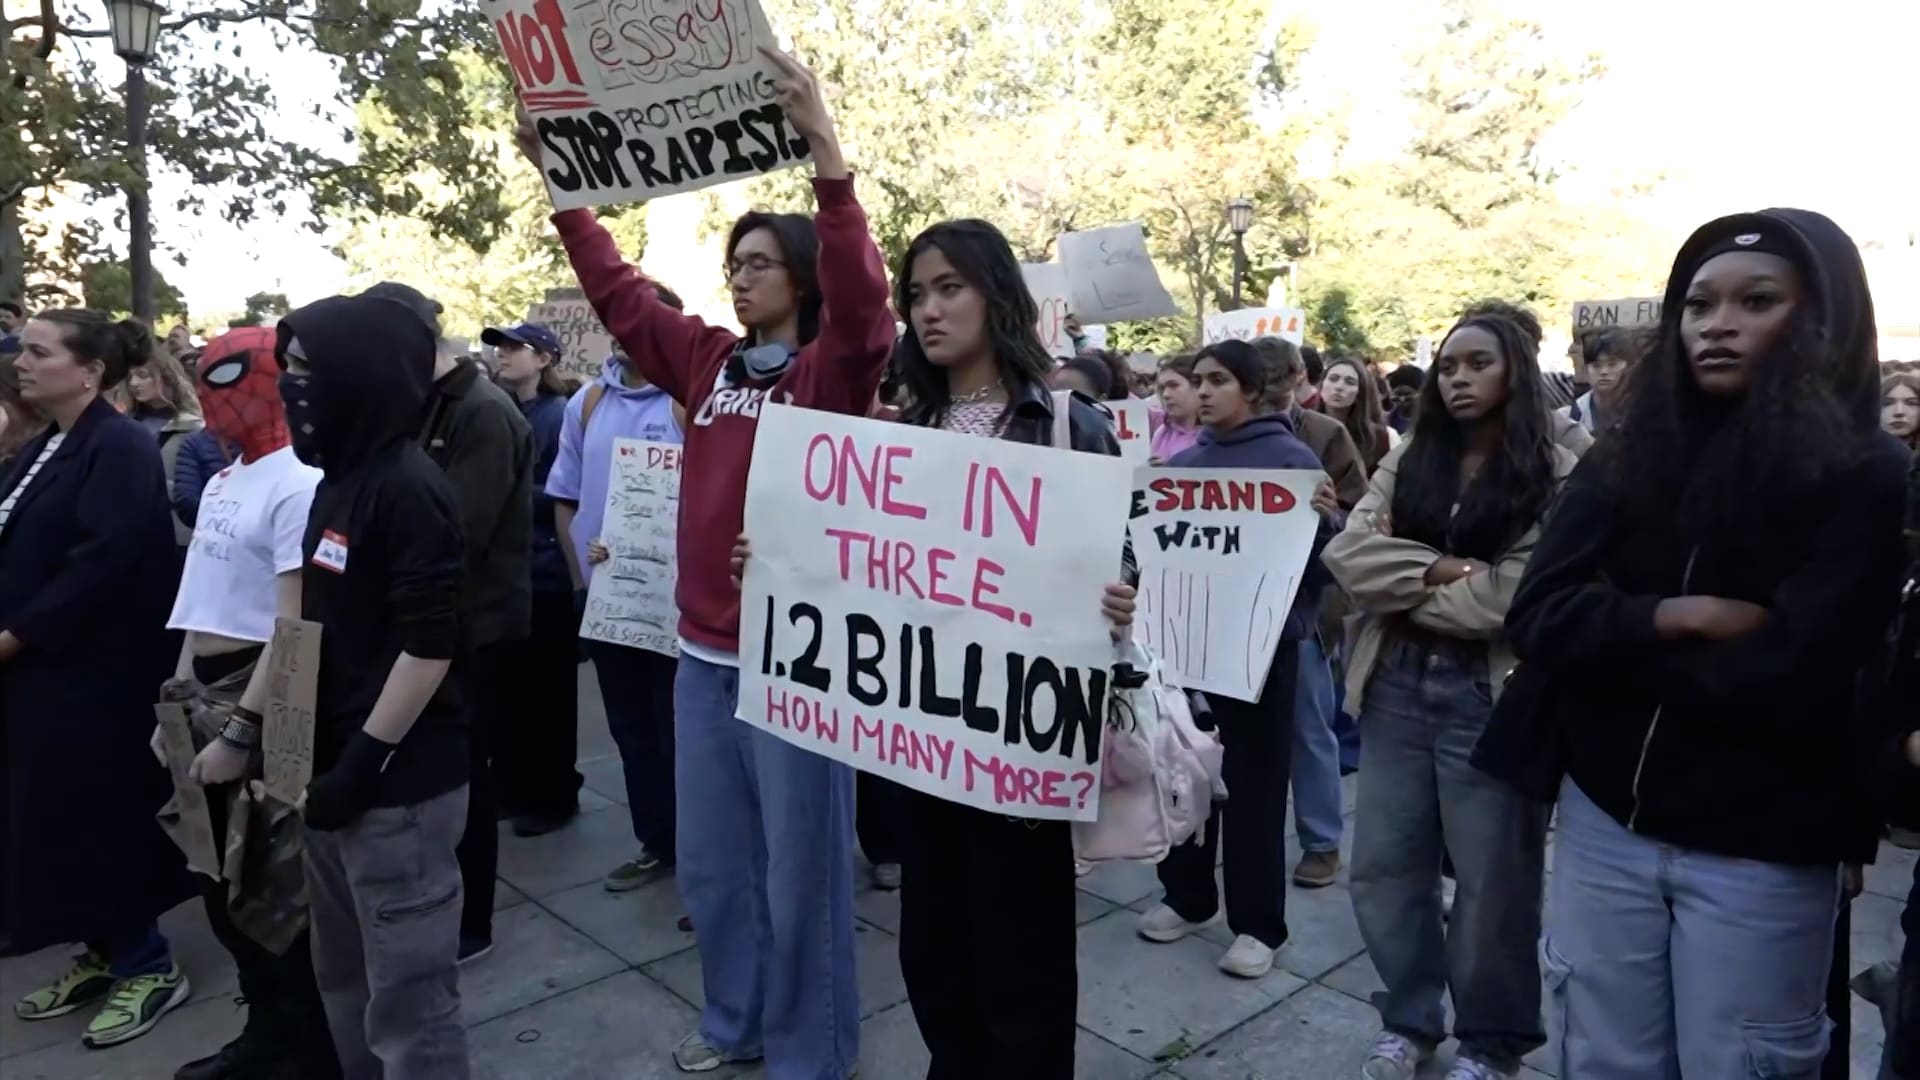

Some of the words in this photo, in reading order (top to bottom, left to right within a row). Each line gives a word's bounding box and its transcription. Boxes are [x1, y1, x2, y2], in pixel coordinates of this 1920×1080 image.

[496, 0, 584, 88] NOT
[589, 0, 732, 70] essay
[615, 71, 779, 133] PROTECTING
[537, 111, 631, 191] STOP
[1578, 304, 1619, 328] BAN
[804, 433, 927, 519] ONE
[963, 463, 1042, 546] IN
[1129, 489, 1149, 520] E
[1149, 478, 1297, 514] STAND
[825, 529, 1032, 627] THREE.
[761, 595, 831, 692] 1.2
[846, 613, 1106, 764] BILLION
[767, 686, 838, 743] HOW
[853, 714, 955, 780] MANY
[964, 749, 1096, 809] MORE?
